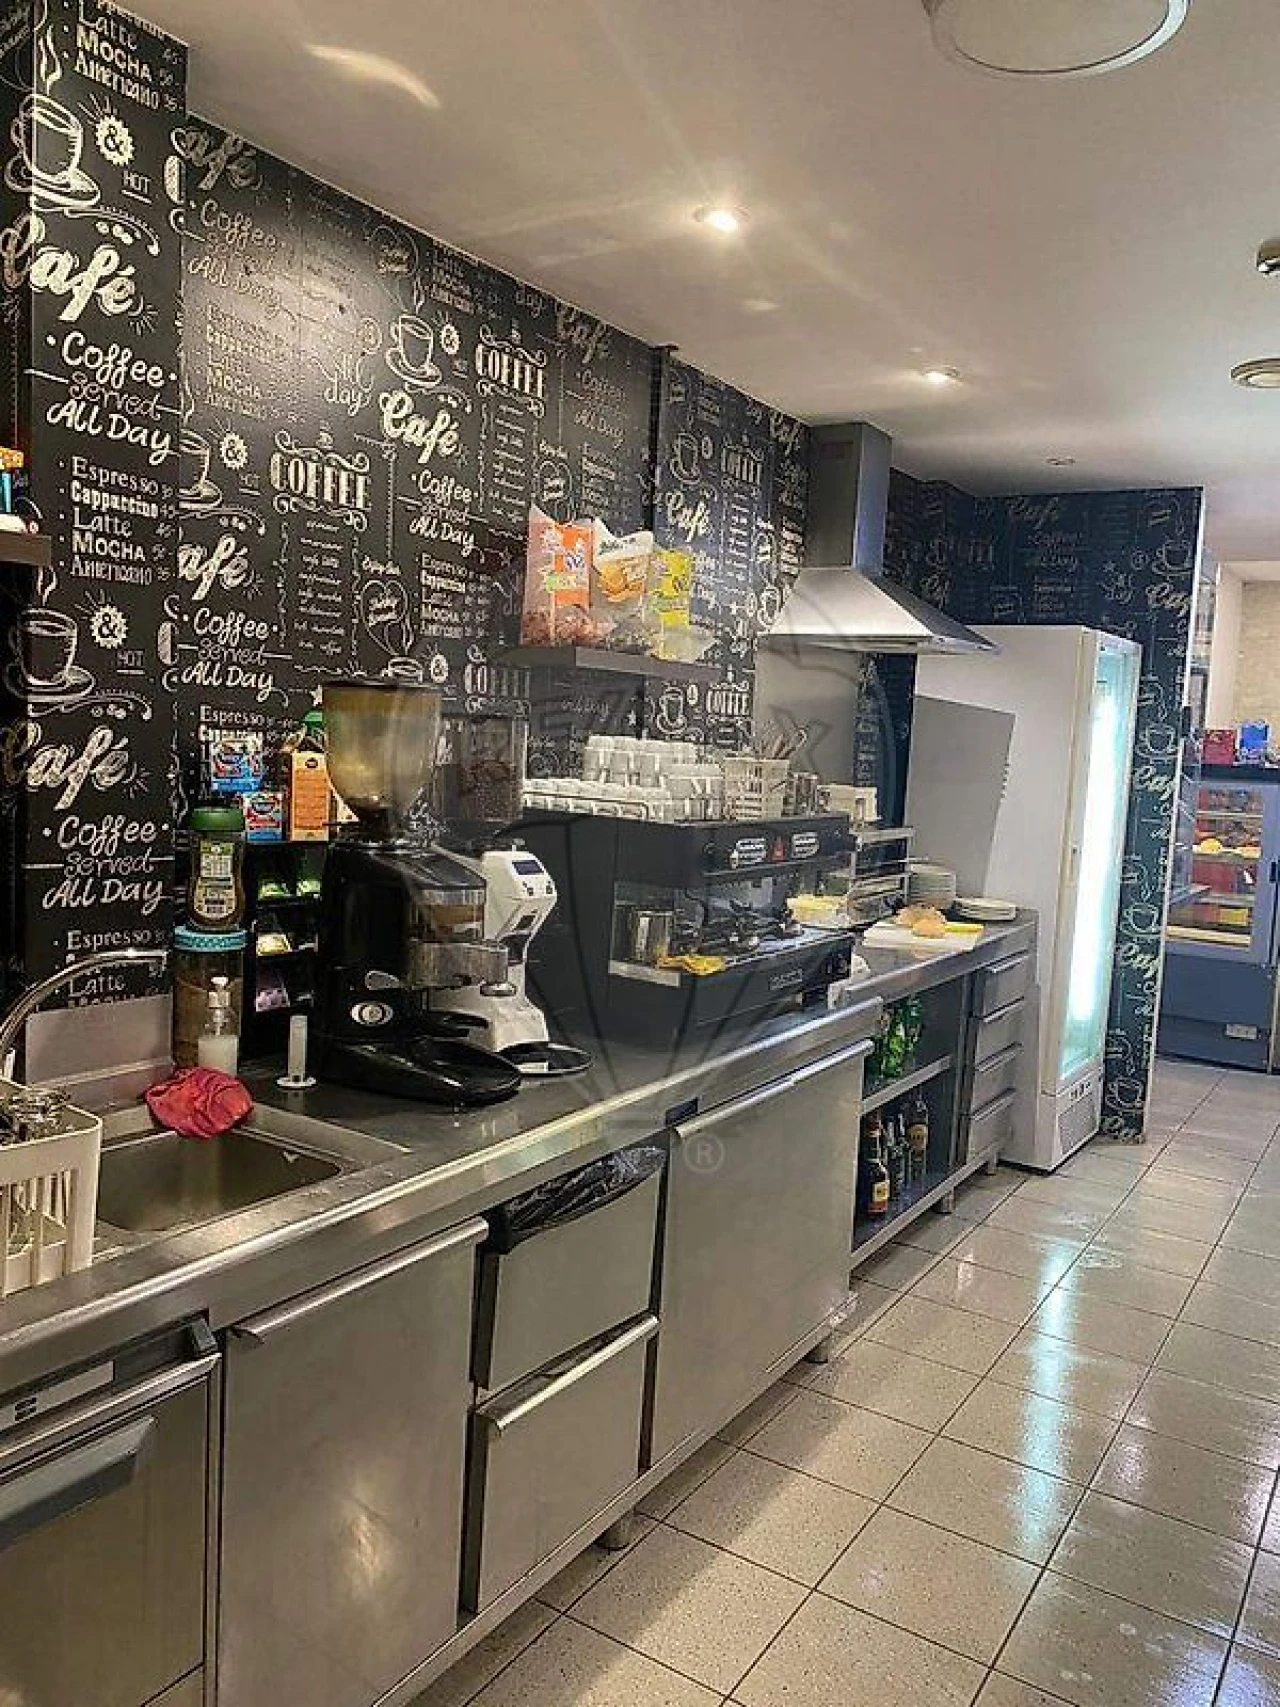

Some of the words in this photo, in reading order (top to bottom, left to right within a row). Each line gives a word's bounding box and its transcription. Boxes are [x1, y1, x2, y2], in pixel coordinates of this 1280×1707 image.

[77, 24, 152, 82] MOCHA
[202, 199, 277, 250] Coffee
[0, 213, 137, 322] Café
[62, 331, 165, 389] Coffee
[47, 398, 103, 435] All
[107, 413, 174, 466] Day
[378, 390, 460, 464] Café
[71, 456, 159, 496] Espresso
[270, 452, 371, 511] COFFEE
[418, 469, 473, 506] Coffee
[74, 506, 132, 539] Latte
[72, 531, 146, 562] MOCHA
[193, 607, 270, 647] Coffee
[181, 660, 223, 686] All
[226, 664, 274, 702] Day
[200, 705, 265, 726] Espresso
[58, 814, 157, 857] Coffee
[42, 875, 98, 910] All
[101, 878, 163, 916] Day
[67, 929, 151, 951] Espresso
